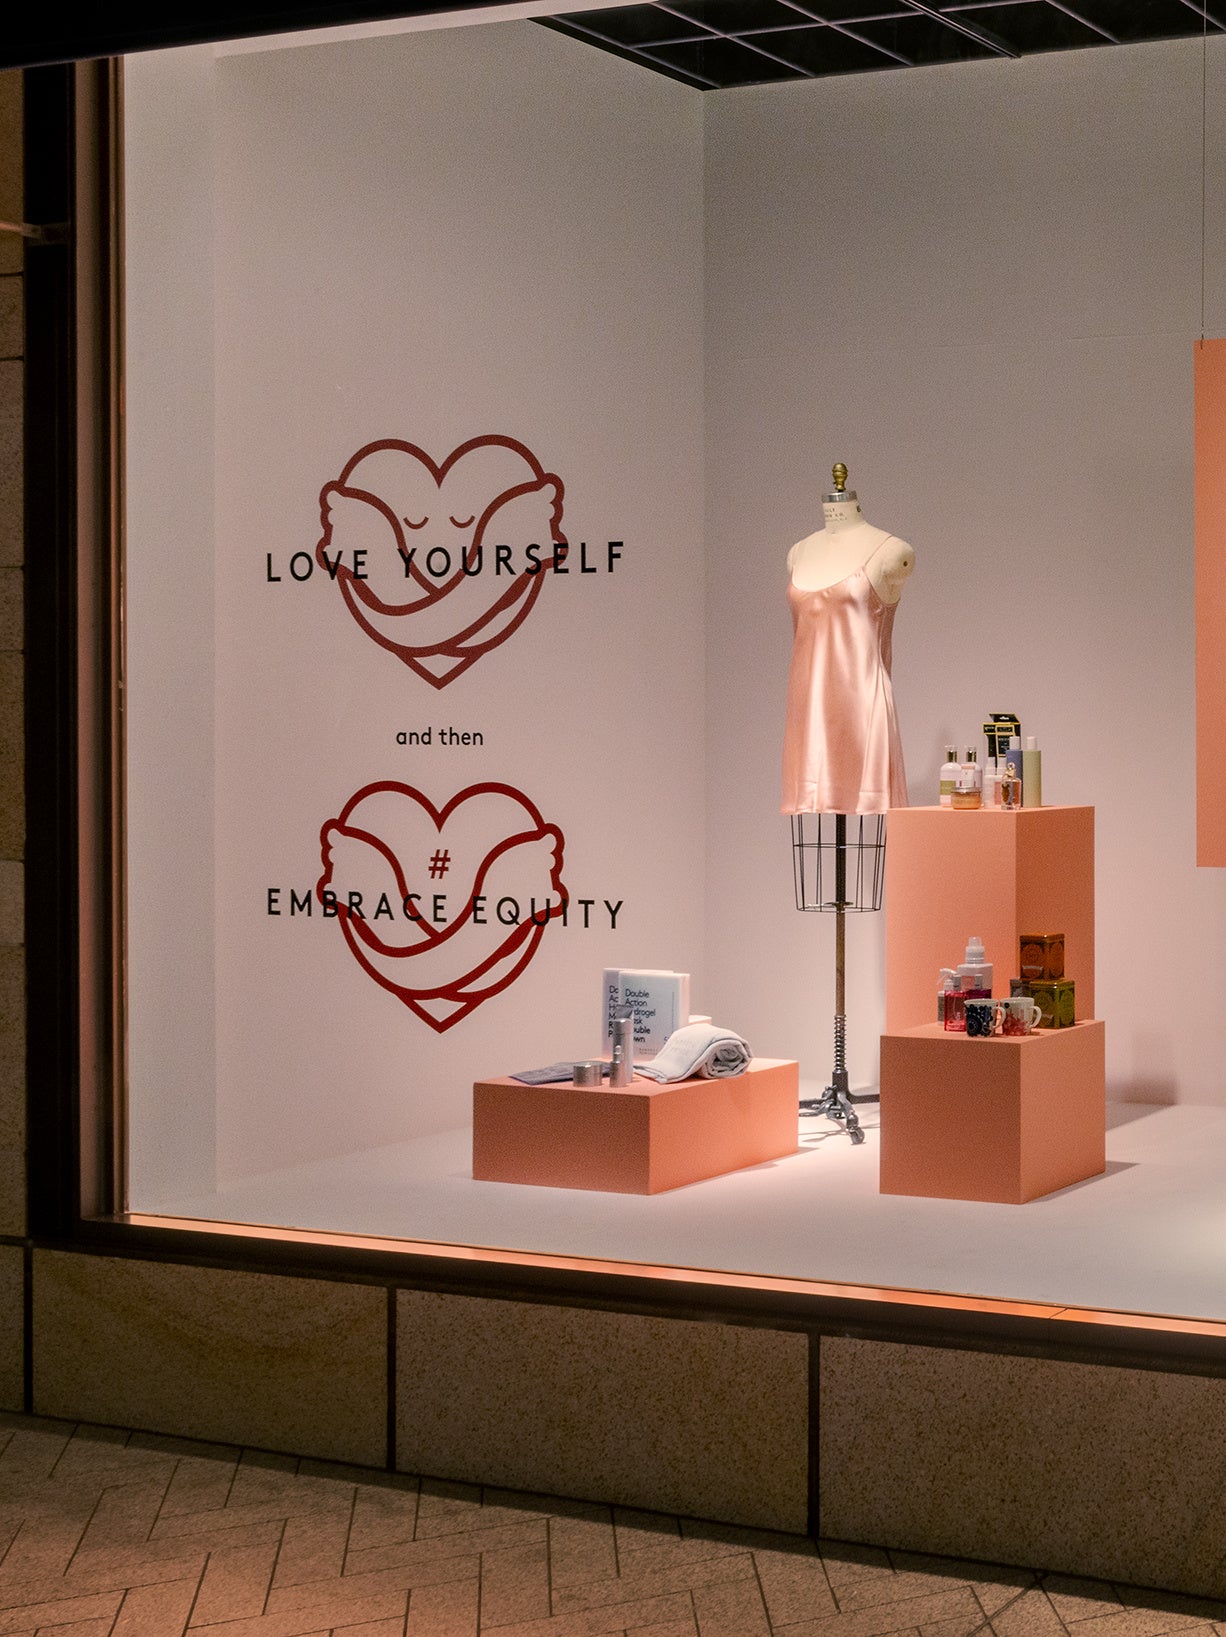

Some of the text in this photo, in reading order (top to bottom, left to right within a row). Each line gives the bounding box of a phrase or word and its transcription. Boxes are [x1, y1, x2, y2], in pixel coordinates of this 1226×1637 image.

[266, 541, 625, 582] LOVE YOURSELF
[396, 727, 483, 745] and then
[267, 888, 625, 930] EMBRACE EQUITY
